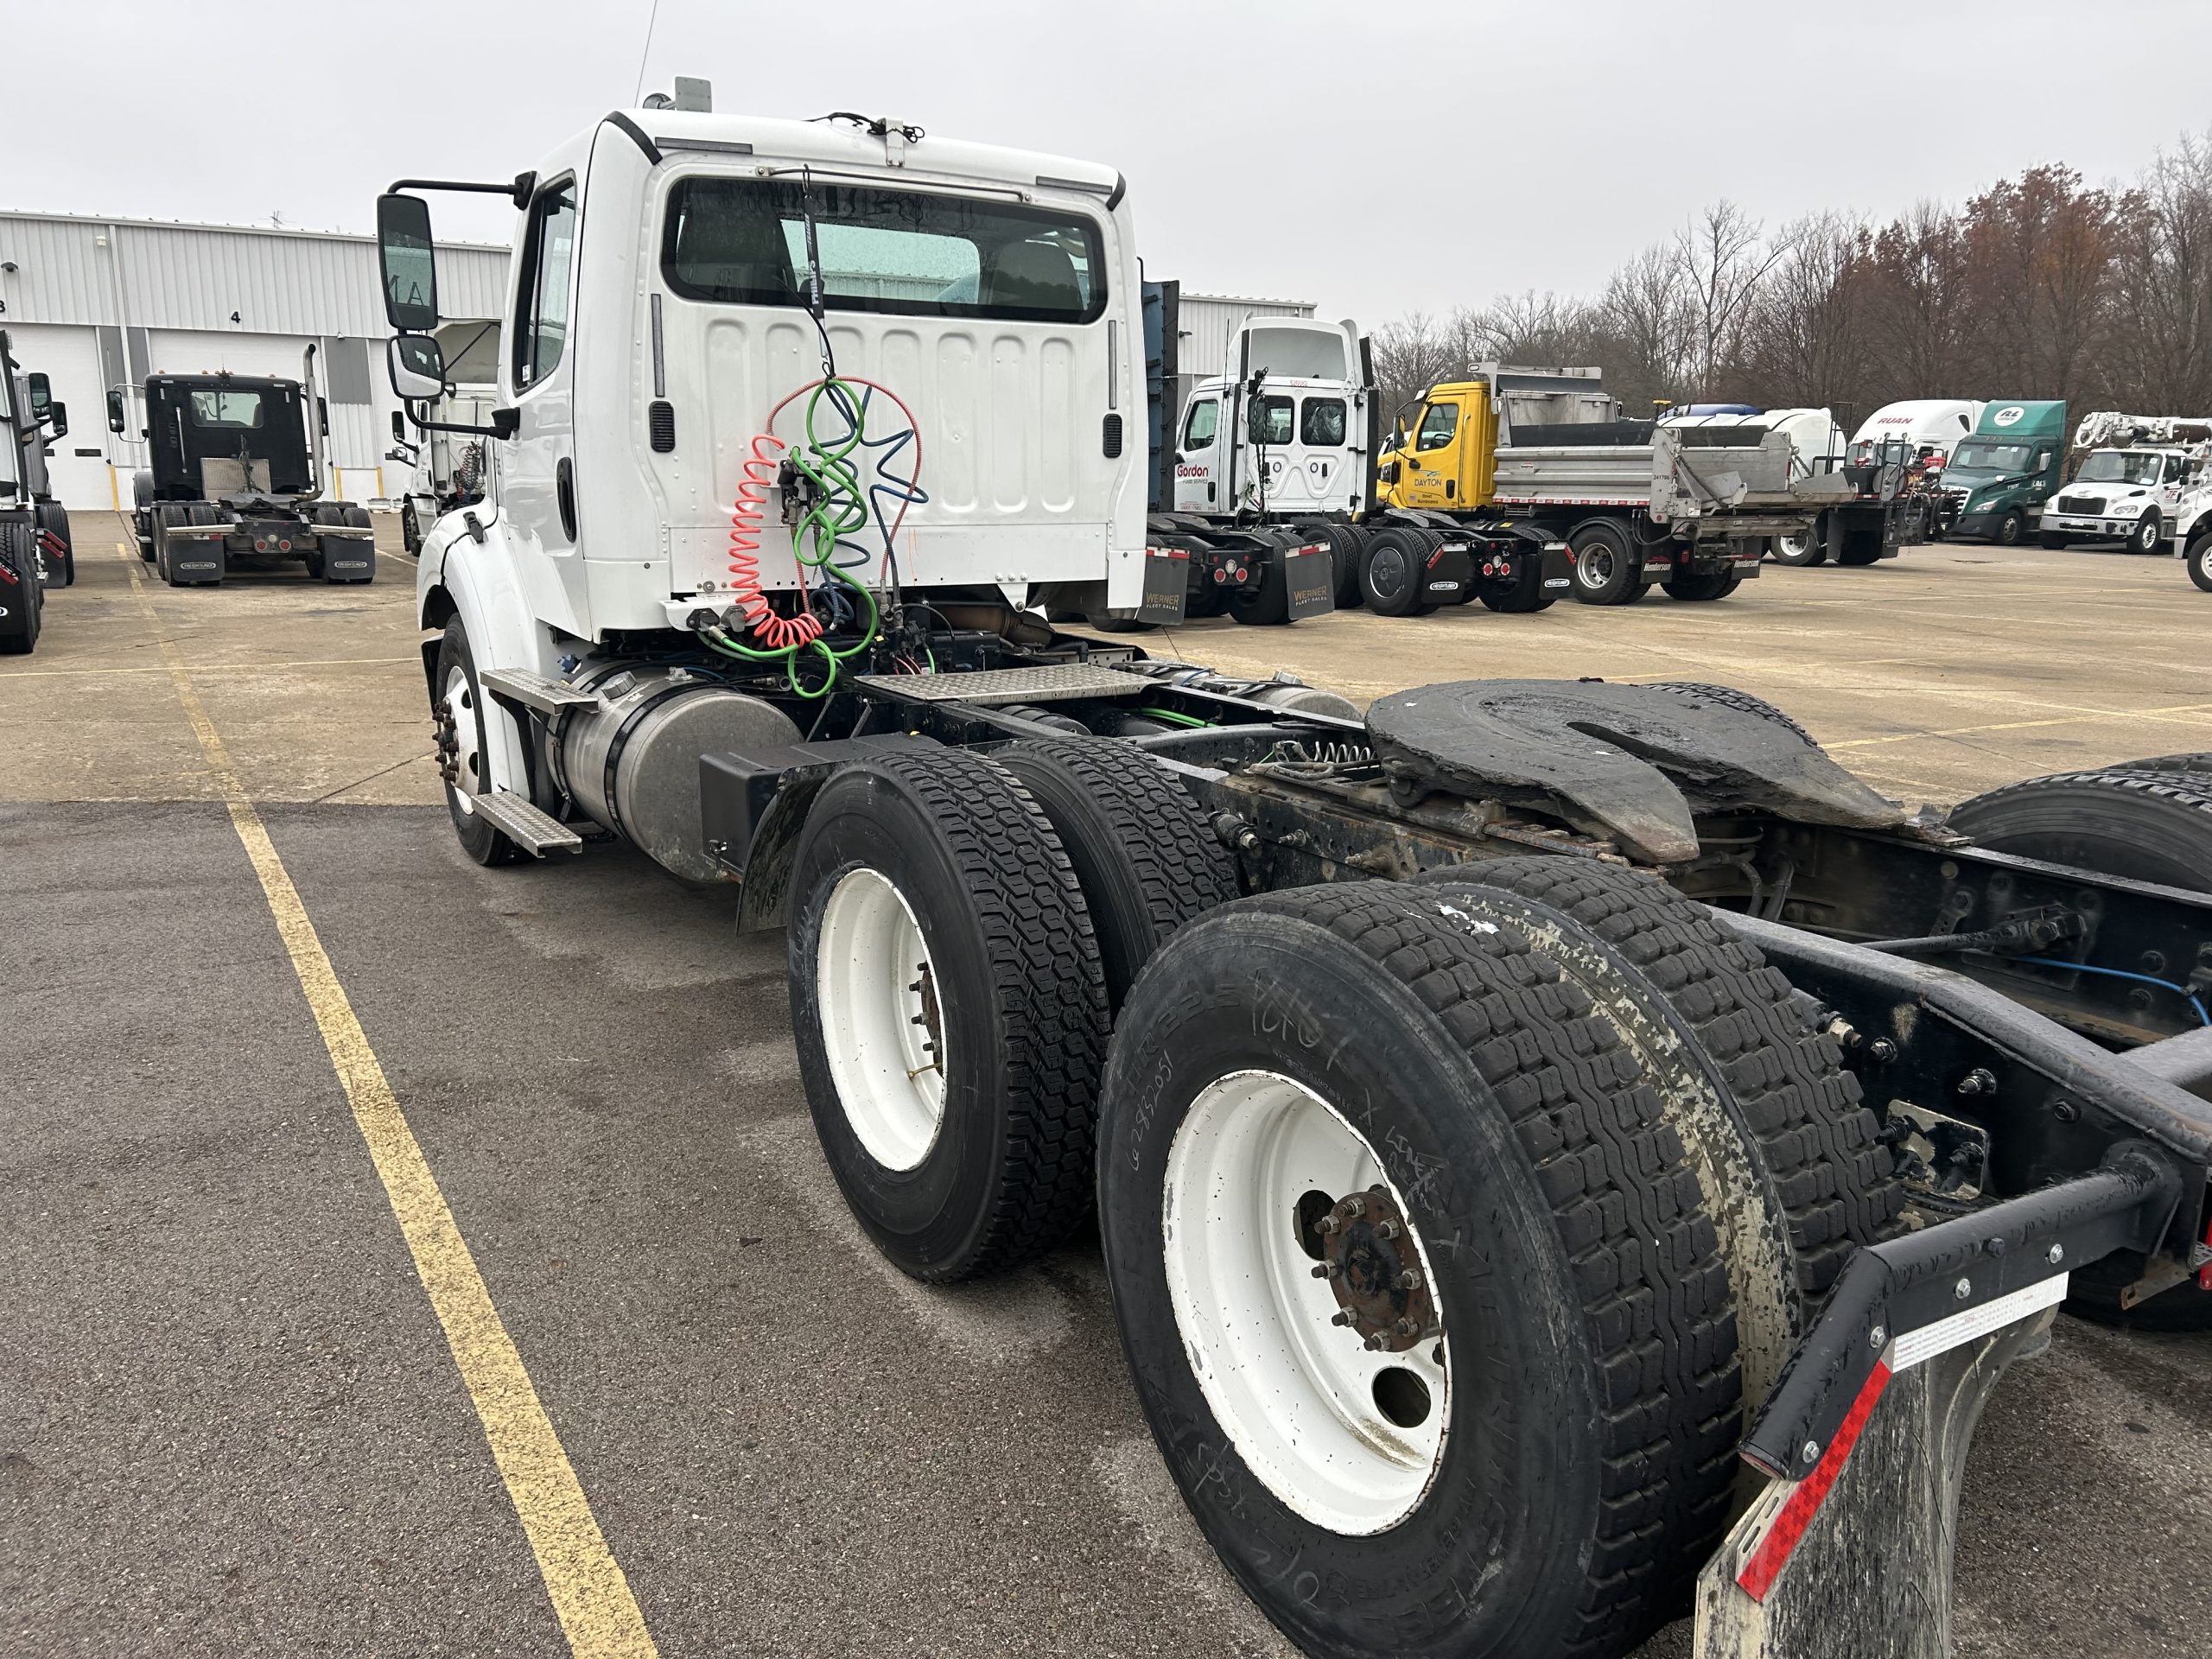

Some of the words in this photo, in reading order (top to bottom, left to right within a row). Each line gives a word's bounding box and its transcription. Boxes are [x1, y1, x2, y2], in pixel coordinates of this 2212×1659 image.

[231, 311, 241, 324] 4
[1177, 464, 1209, 477] Gordon
[1414, 478, 1442, 486] DAYTON
[1643, 563, 1672, 572] Henderson
[1733, 559, 1759, 569] Henderson
[1146, 591, 1179, 605] WERNER
[1294, 585, 1327, 601] WERNER
